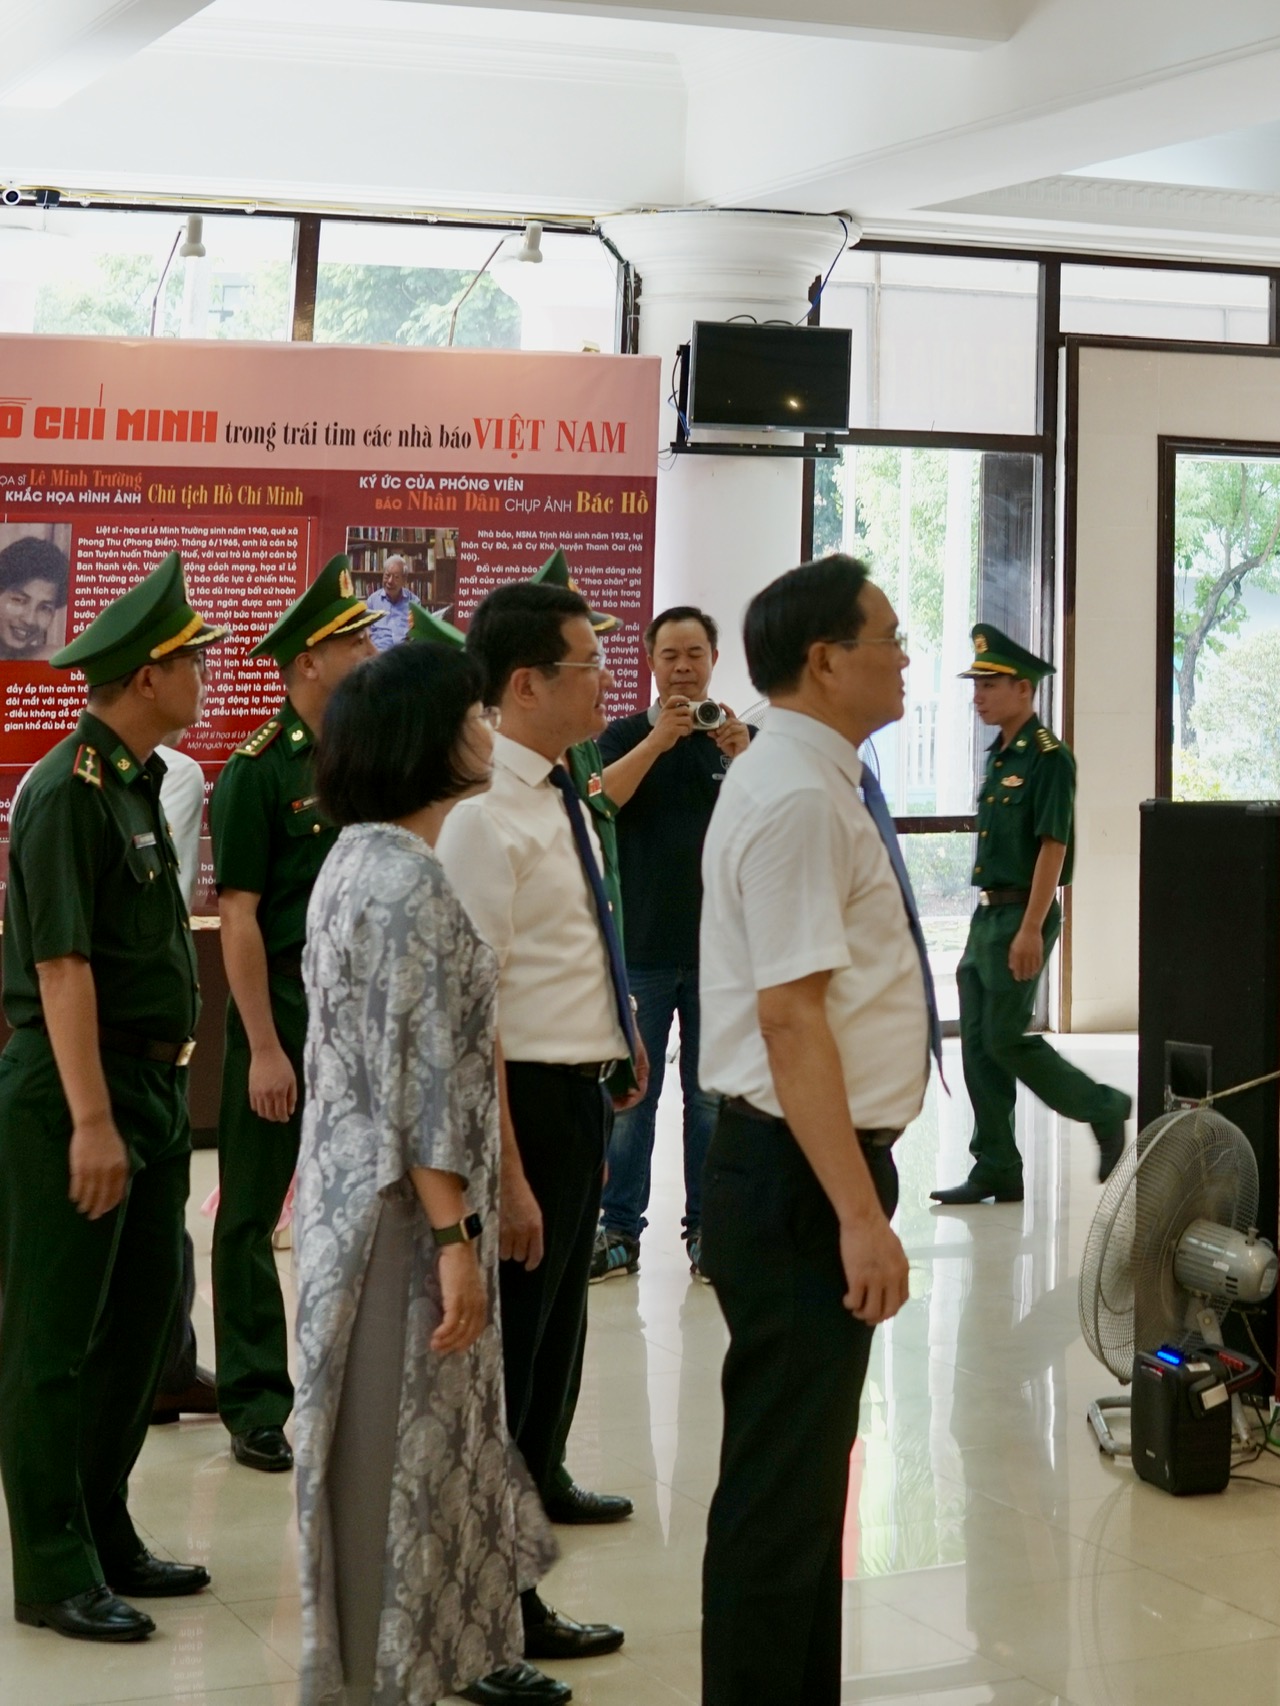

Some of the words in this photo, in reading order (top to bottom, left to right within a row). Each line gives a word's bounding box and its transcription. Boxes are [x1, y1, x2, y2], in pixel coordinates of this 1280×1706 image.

[34, 383, 106, 440] CHÍ
[116, 409, 218, 442] MINH
[226, 421, 276, 452] trong
[283, 422, 318, 445] trái
[325, 422, 355, 446] tim
[363, 424, 392, 448] các
[398, 424, 433, 448] nhà
[439, 424, 471, 449] báo
[472, 413, 545, 459] VIỆT
[555, 420, 628, 453] NAM
[18, 474, 28, 485] SĨ
[30, 469, 46, 486] Lê
[51, 470, 87, 487] Minh
[93, 470, 143, 491] Trường
[359, 474, 377, 488] KÝ
[382, 474, 401, 489] ỨC
[405, 474, 435, 490] CỦA
[439, 476, 489, 490] PHÓNG
[494, 476, 524, 491] VIÊN
[6, 487, 42, 502] KHẮC
[46, 491, 75, 505] HỌA
[79, 489, 112, 504] HÌNH
[114, 489, 141, 504] ẢNH
[148, 484, 176, 504] Chủ
[181, 484, 208, 509] tịch
[214, 483, 232, 504] Hồ
[238, 485, 261, 505] Chí
[267, 486, 303, 506] Minh
[375, 496, 402, 510] BÁO
[407, 490, 457, 511] Nhân
[465, 492, 499, 512] Dân
[505, 499, 540, 514] CHỤP
[544, 496, 571, 512] ẢNH
[576, 490, 613, 513] Bác
[621, 490, 648, 514] Hồ
[96, 527, 110, 535] Liệt
[112, 526, 118, 534] sĩ
[124, 527, 139, 536] họa
[141, 526, 148, 534] sĩ
[181, 527, 208, 536] Trường
[210, 527, 226, 535] sinh
[228, 527, 246, 535] năm
[248, 527, 269, 536] 1940,
[271, 527, 286, 536] quê
[478, 530, 493, 538] Nhà
[496, 530, 513, 539] báo,
[539, 531, 557, 540] Trịnh
[559, 531, 572, 539] Hải
[611, 532, 631, 541] 1932,
[633, 533, 643, 541] tại
